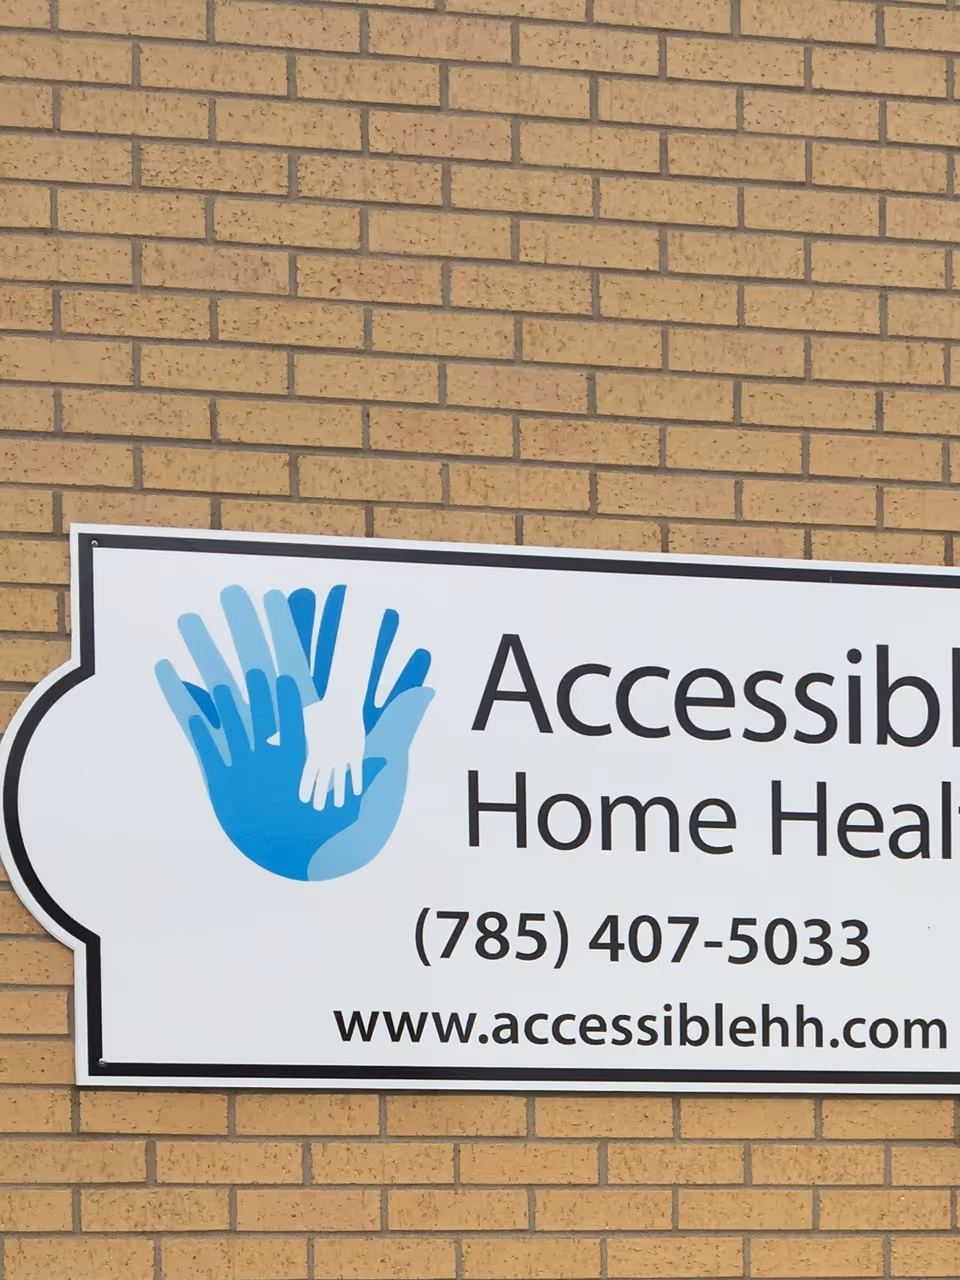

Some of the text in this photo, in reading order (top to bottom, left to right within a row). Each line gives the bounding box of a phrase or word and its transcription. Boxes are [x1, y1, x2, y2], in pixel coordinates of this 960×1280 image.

[467, 769, 738, 855] Home
[415, 907, 870, 970] (785) 407-5033
[332, 1002, 948, 1050] www.accessiblehh.com
